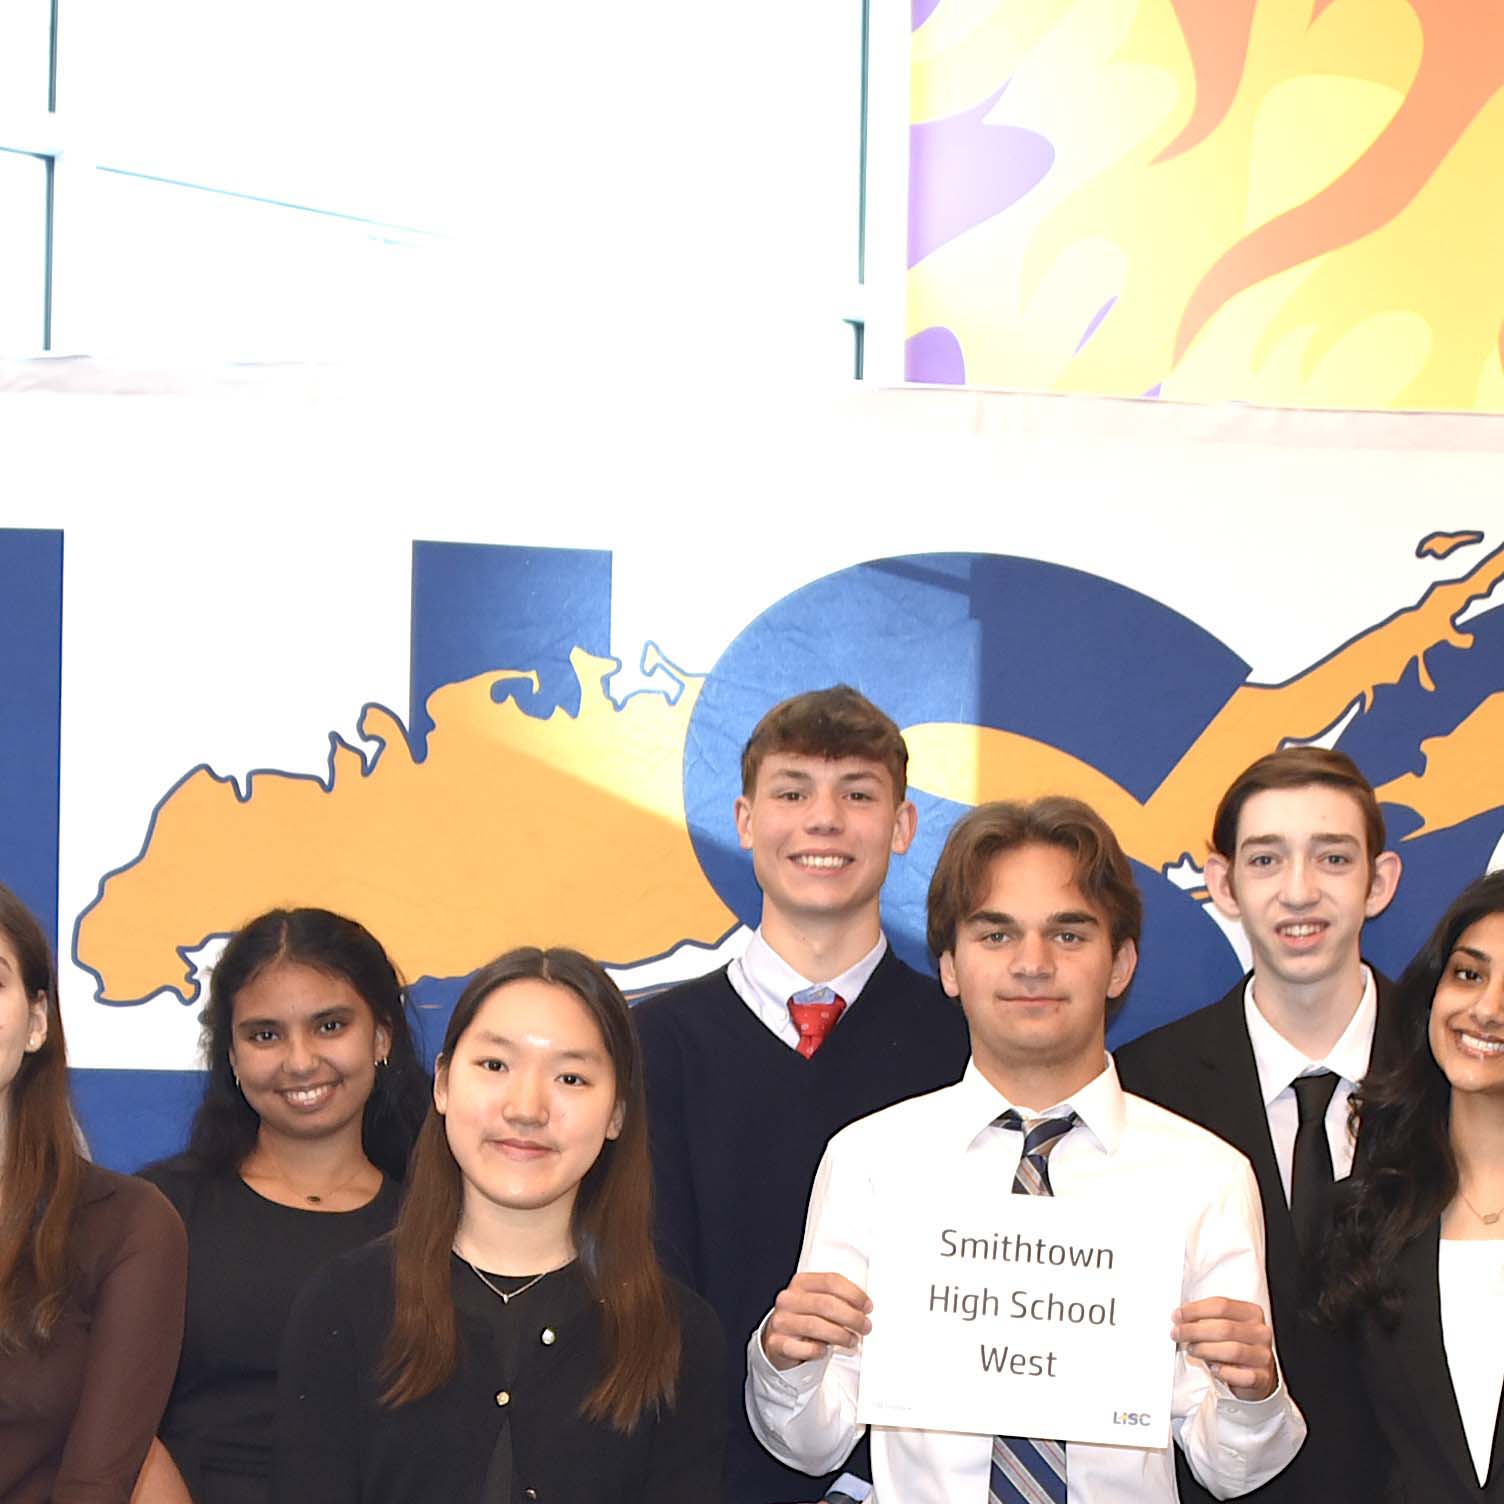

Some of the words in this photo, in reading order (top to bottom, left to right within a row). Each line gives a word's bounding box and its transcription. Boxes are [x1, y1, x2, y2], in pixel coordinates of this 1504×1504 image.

[940, 1229, 1114, 1270] Smithtown
[929, 1284, 999, 1322] High
[1010, 1290, 1116, 1326] School
[980, 1344, 1057, 1378] West
